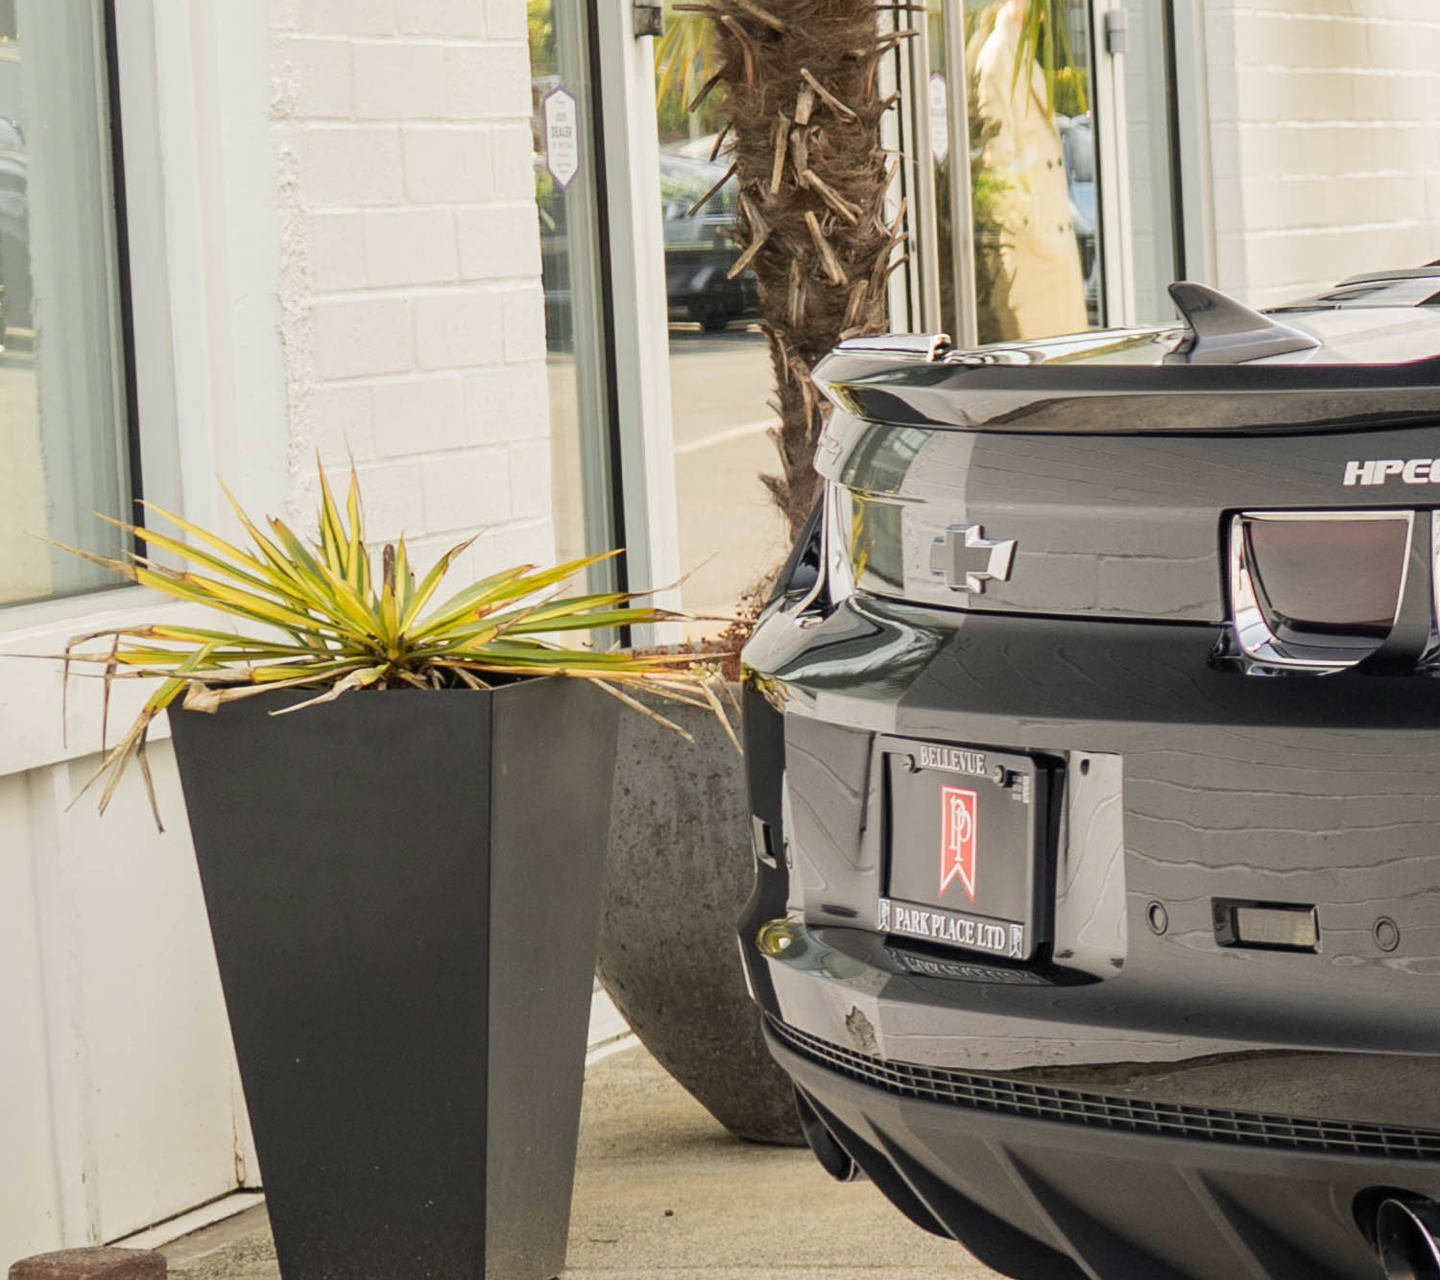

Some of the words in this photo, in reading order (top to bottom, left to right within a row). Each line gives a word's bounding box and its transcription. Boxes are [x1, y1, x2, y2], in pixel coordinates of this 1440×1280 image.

[919, 745, 987, 775] BELLEVUE
[894, 906, 930, 936] PARK
[931, 913, 976, 946] PLACE
[976, 922, 1007, 951] LTD
